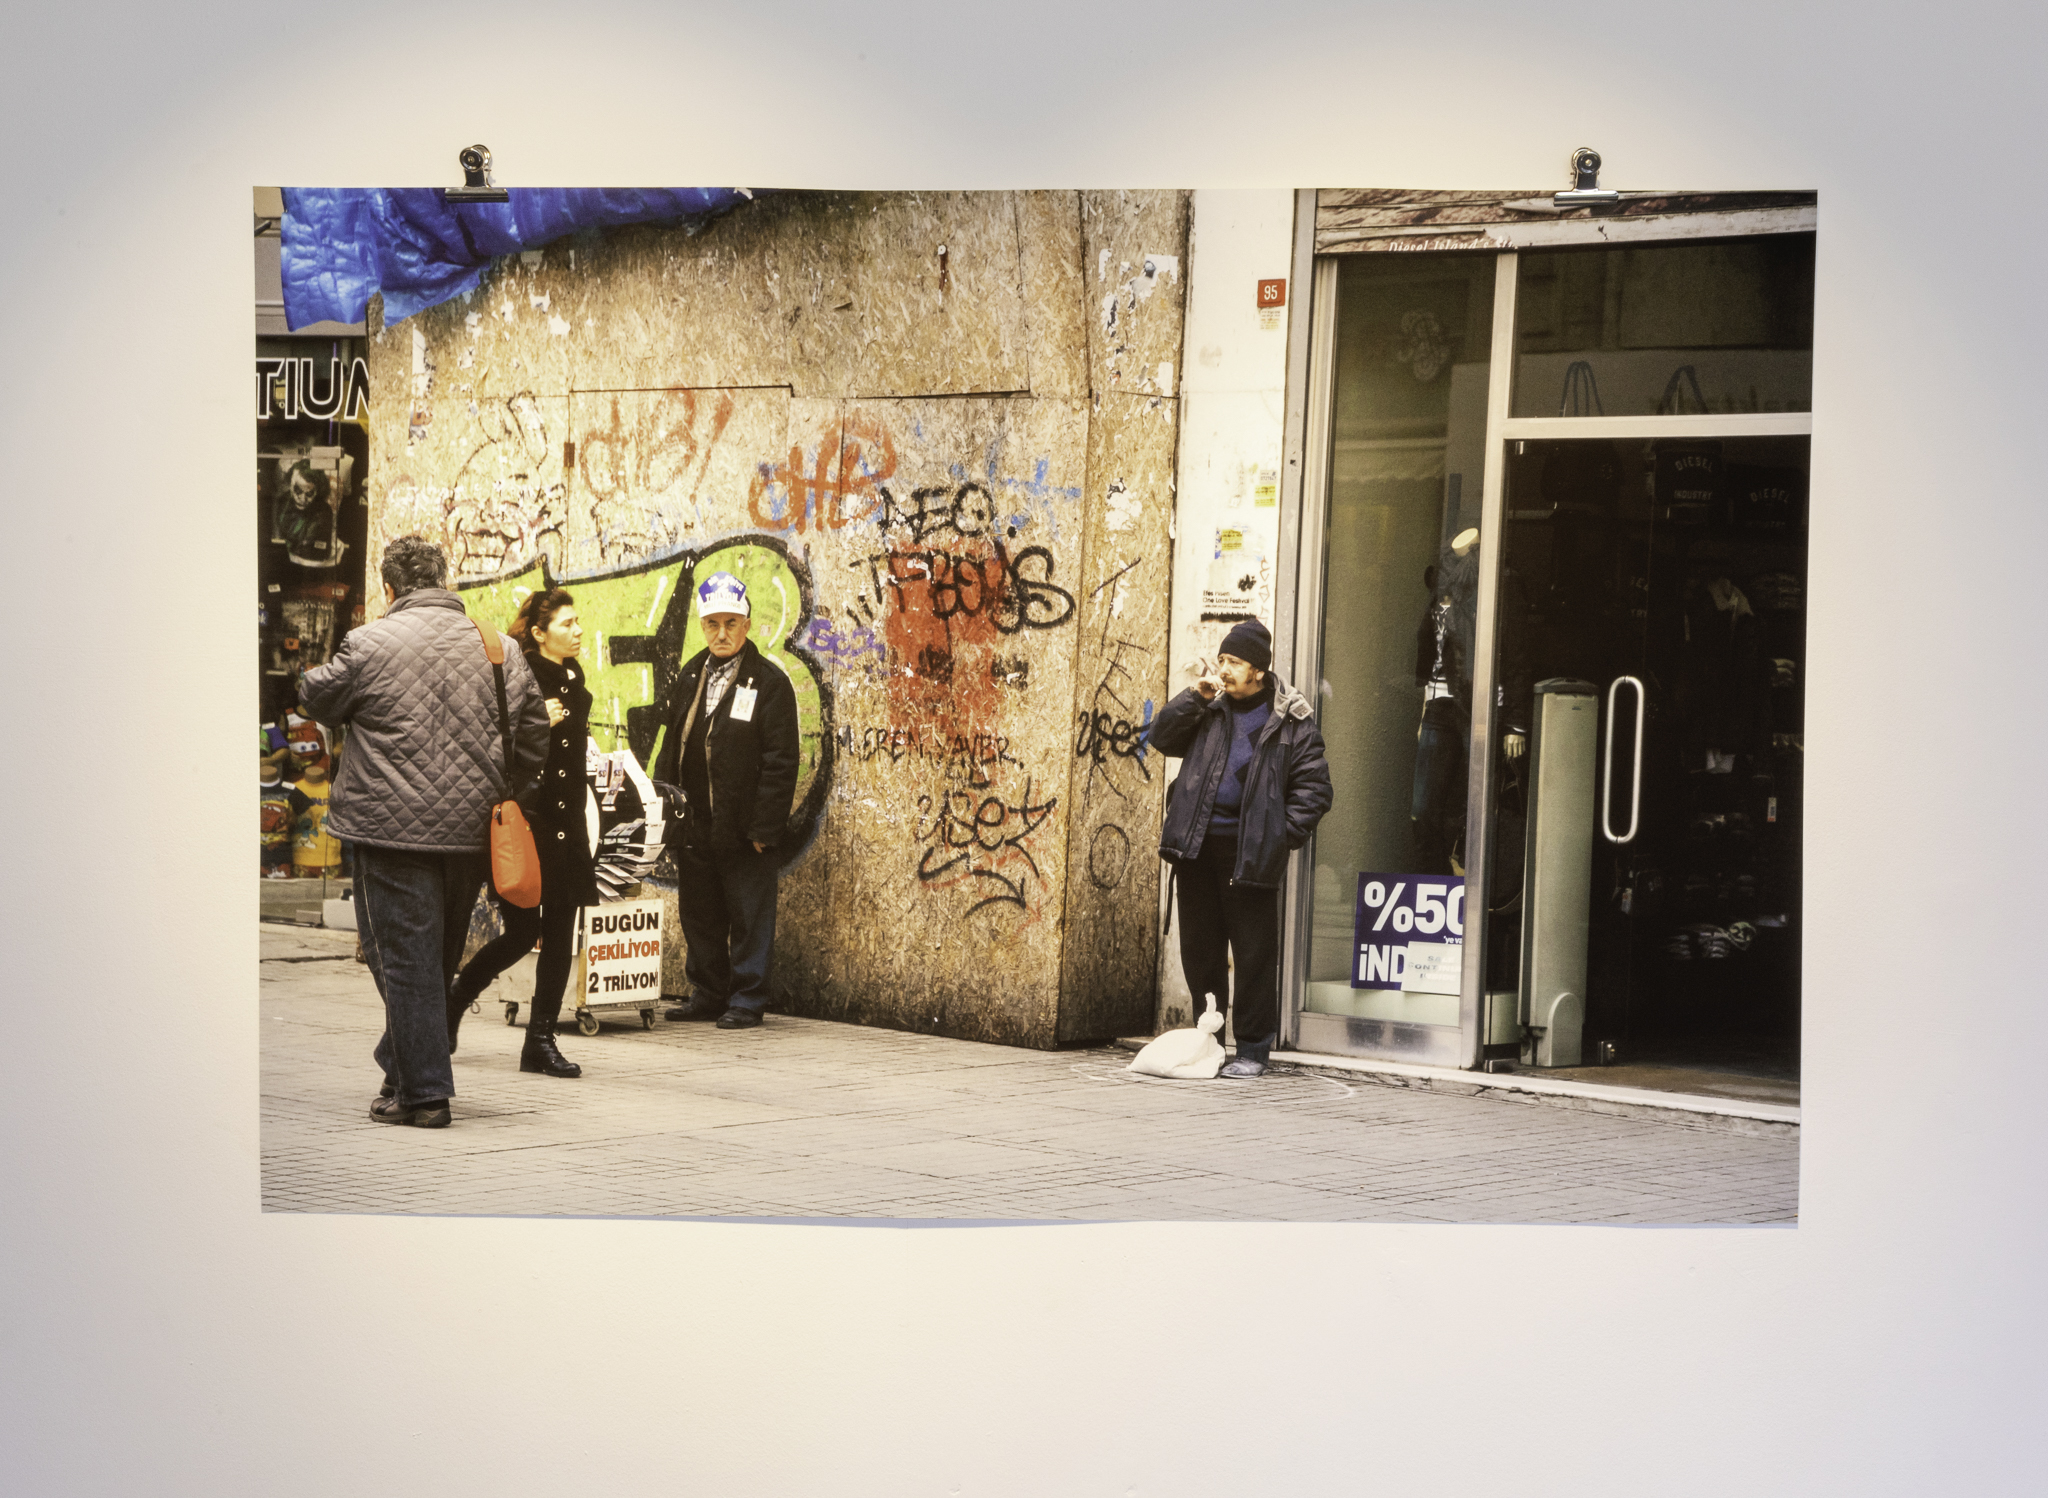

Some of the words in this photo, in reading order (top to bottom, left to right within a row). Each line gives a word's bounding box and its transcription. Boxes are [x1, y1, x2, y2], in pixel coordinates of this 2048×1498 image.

[1264, 284, 1278, 301] 95
[1674, 456, 1713, 473] DIESEL
[1749, 487, 1791, 504] DIESEL
[1202, 596, 1215, 604] One
[1364, 881, 1464, 936] %50
[591, 908, 659, 935] BUGÜN
[588, 938, 660, 967] ÇEKİLİYOR
[588, 971, 599, 994] 2
[603, 970, 659, 993] TRİLYON
